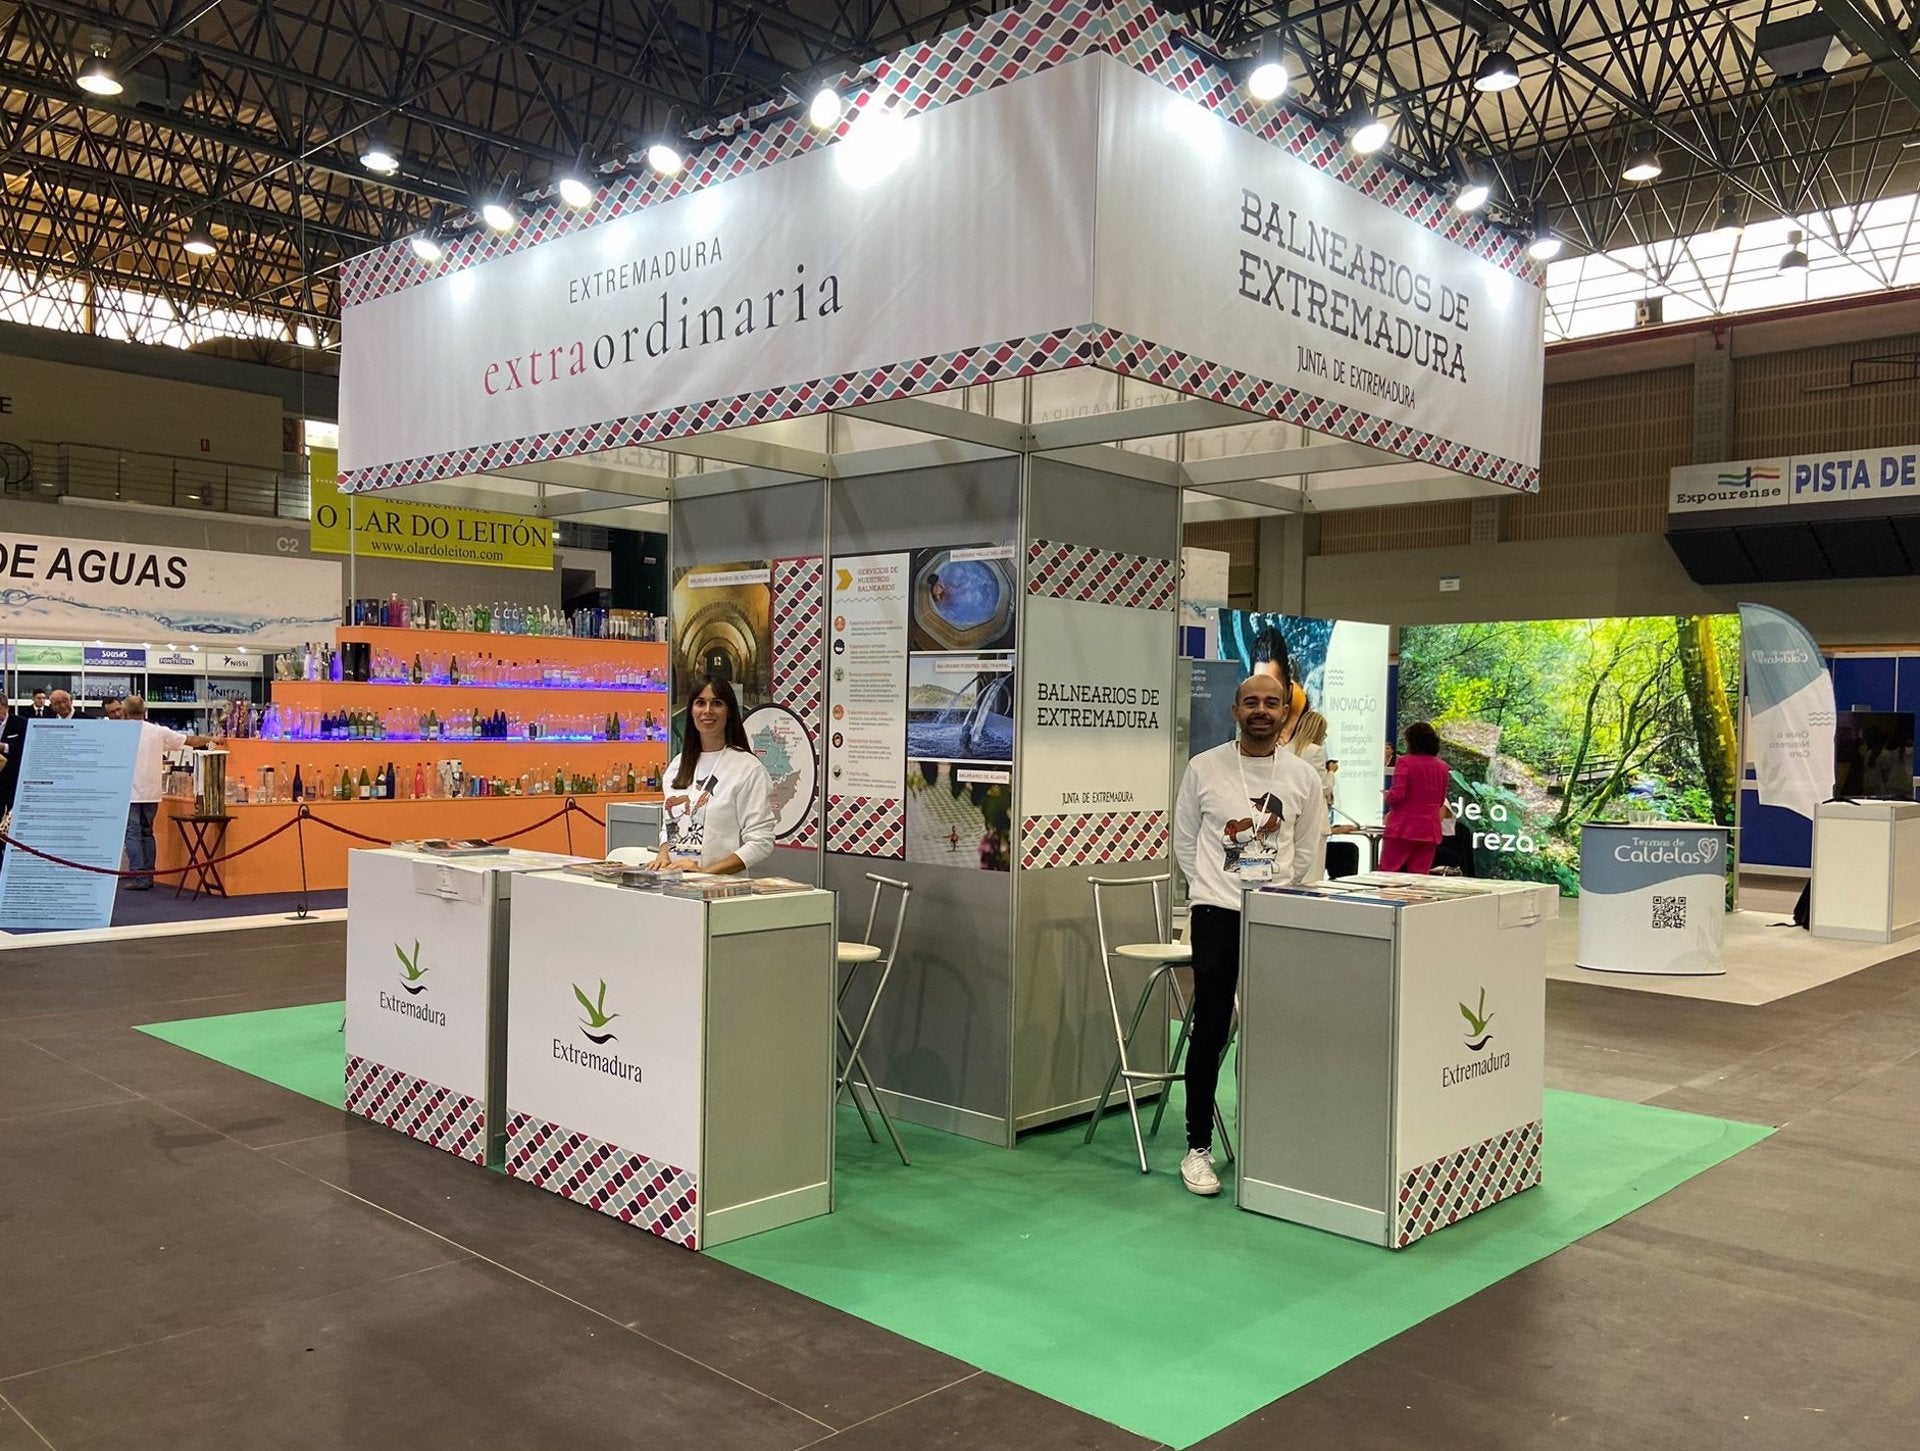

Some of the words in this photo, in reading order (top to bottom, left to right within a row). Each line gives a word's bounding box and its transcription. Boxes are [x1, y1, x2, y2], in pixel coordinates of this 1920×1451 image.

[569, 236, 722, 304] EXTREMADURA
[1240, 187, 1431, 314] BALNEARIOS
[1439, 284, 1470, 332] DE
[483, 263, 844, 396] extraordinaria
[1239, 248, 1467, 384] EXTREMADURA
[1297, 345, 1329, 379] JUNTA
[1333, 358, 1346, 385] DE
[1350, 364, 1416, 410] EXTREMADURA
[1795, 458, 1871, 494] PISTA
[1880, 455, 1917, 487] DE
[1676, 486, 1782, 504] Expourense
[317, 504, 338, 529] O
[347, 507, 404, 536] LAR
[411, 514, 450, 539] DO
[457, 518, 548, 547] LEITÓN
[276, 537, 299, 553] C2
[371, 540, 504, 562] www.olardoleiton.com
[46, 547, 188, 590] AGUAS
[1037, 683, 1136, 705] BALNEARIOS
[1141, 689, 1160, 706] DE
[1329, 694, 1377, 715] INOVAÇÃO
[1037, 707, 1160, 729] EXTREMADURA
[1062, 792, 1080, 806] JUNTA
[1082, 792, 1090, 804] DE
[1092, 791, 1134, 803] EXTREMADURA
[1489, 804, 1507, 822] a
[1614, 845, 1700, 864] Caldelas
[1632, 837, 1670, 847] Termas
[1673, 838, 1685, 847] de
[380, 991, 447, 1027] Extremadura
[553, 1038, 643, 1084] Extremadura
[1442, 1051, 1511, 1089] Extremadura
